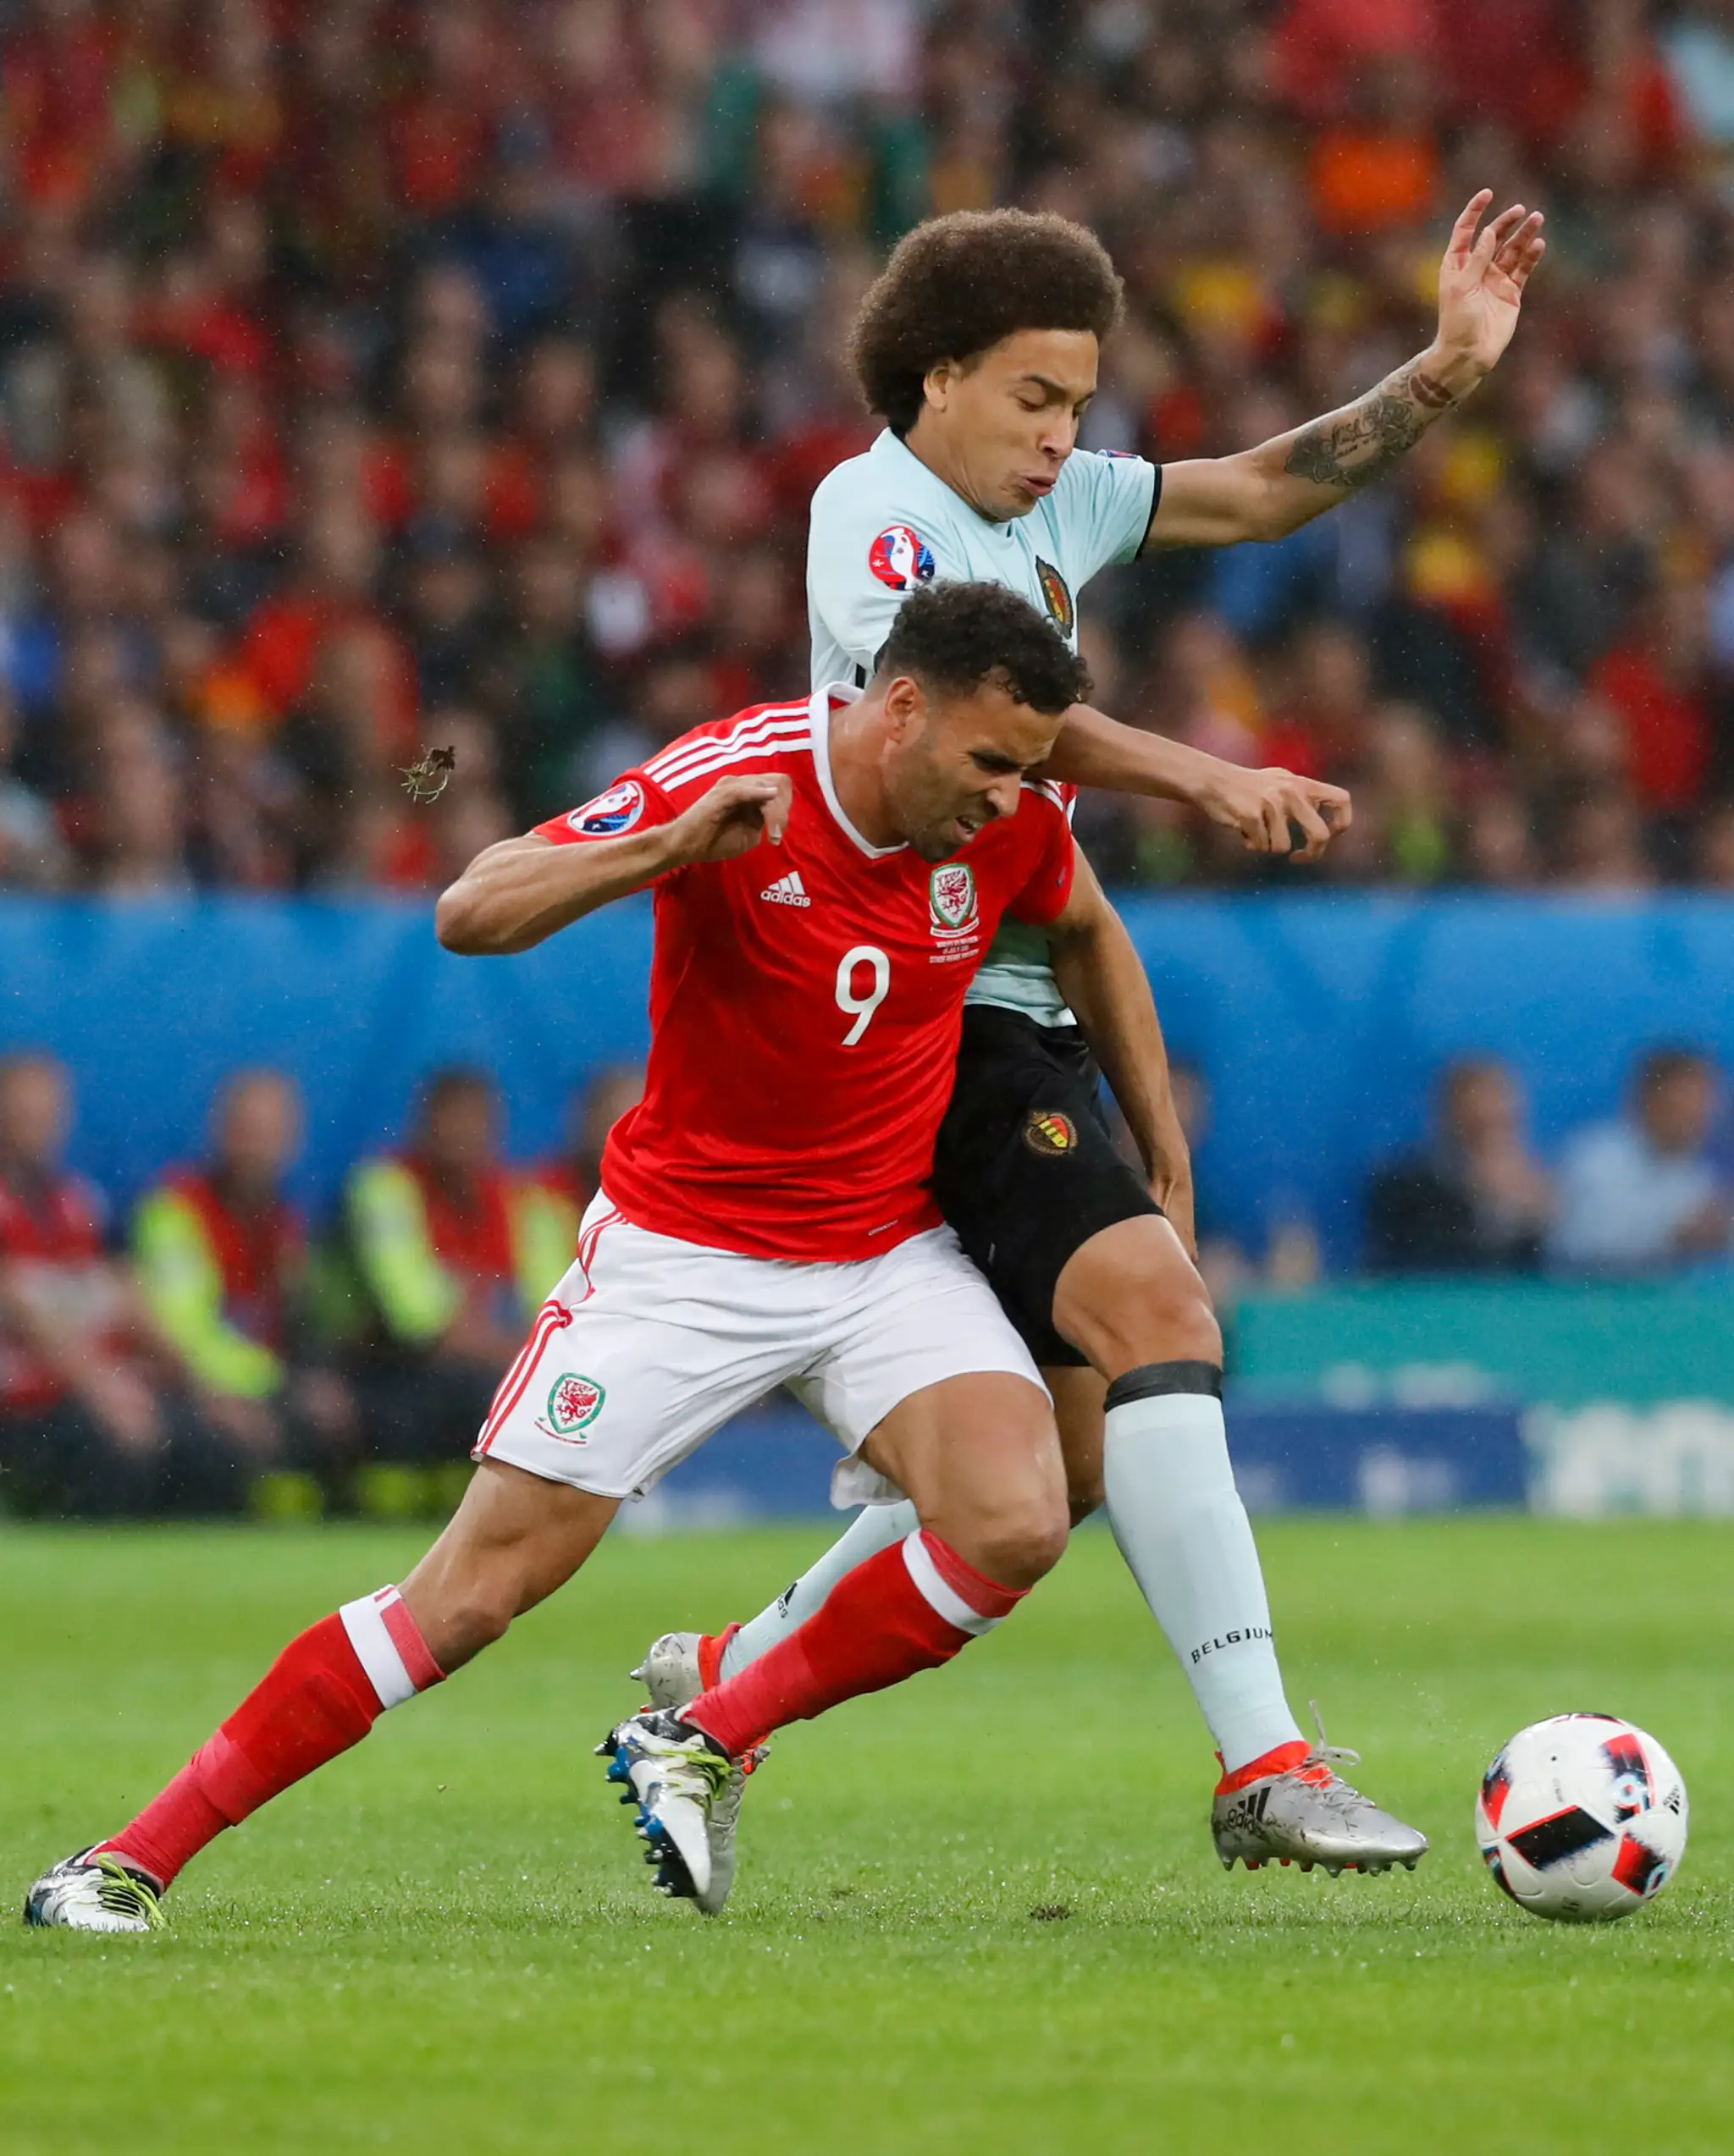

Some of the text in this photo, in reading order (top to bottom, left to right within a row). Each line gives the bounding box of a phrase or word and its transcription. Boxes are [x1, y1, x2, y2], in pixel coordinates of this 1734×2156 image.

[760, 890, 811, 908] adidas
[835, 945, 890, 1046] 9
[1190, 1628, 1273, 1664] BELGIUM
